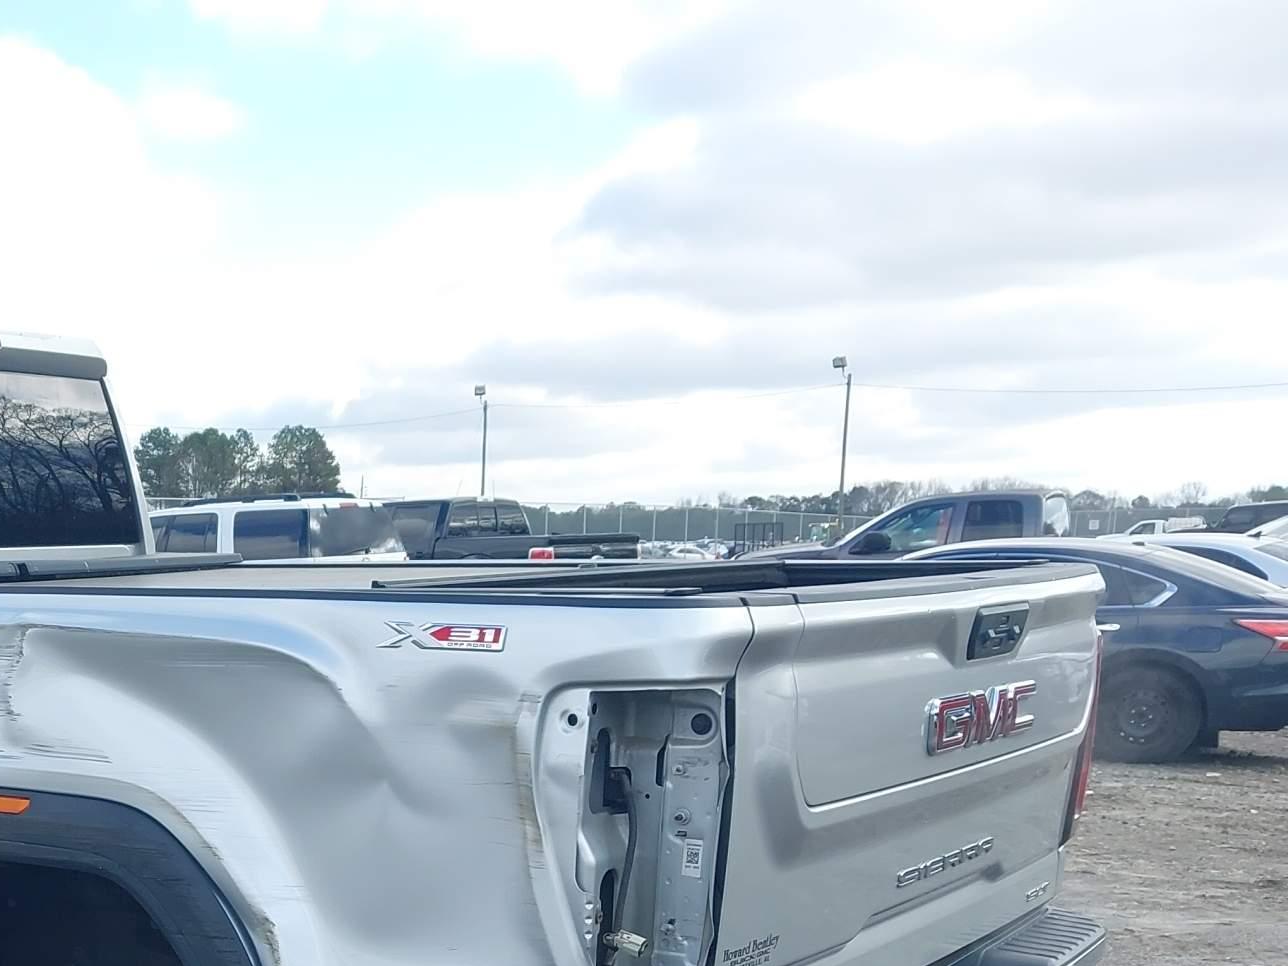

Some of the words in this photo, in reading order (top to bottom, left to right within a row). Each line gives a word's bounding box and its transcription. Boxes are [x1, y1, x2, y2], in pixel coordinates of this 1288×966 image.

[922, 680, 1037, 756] GMC
[896, 836, 994, 888] SIERRA
[722, 941, 752, 963] Howard
[752, 933, 780, 952] Bentley
